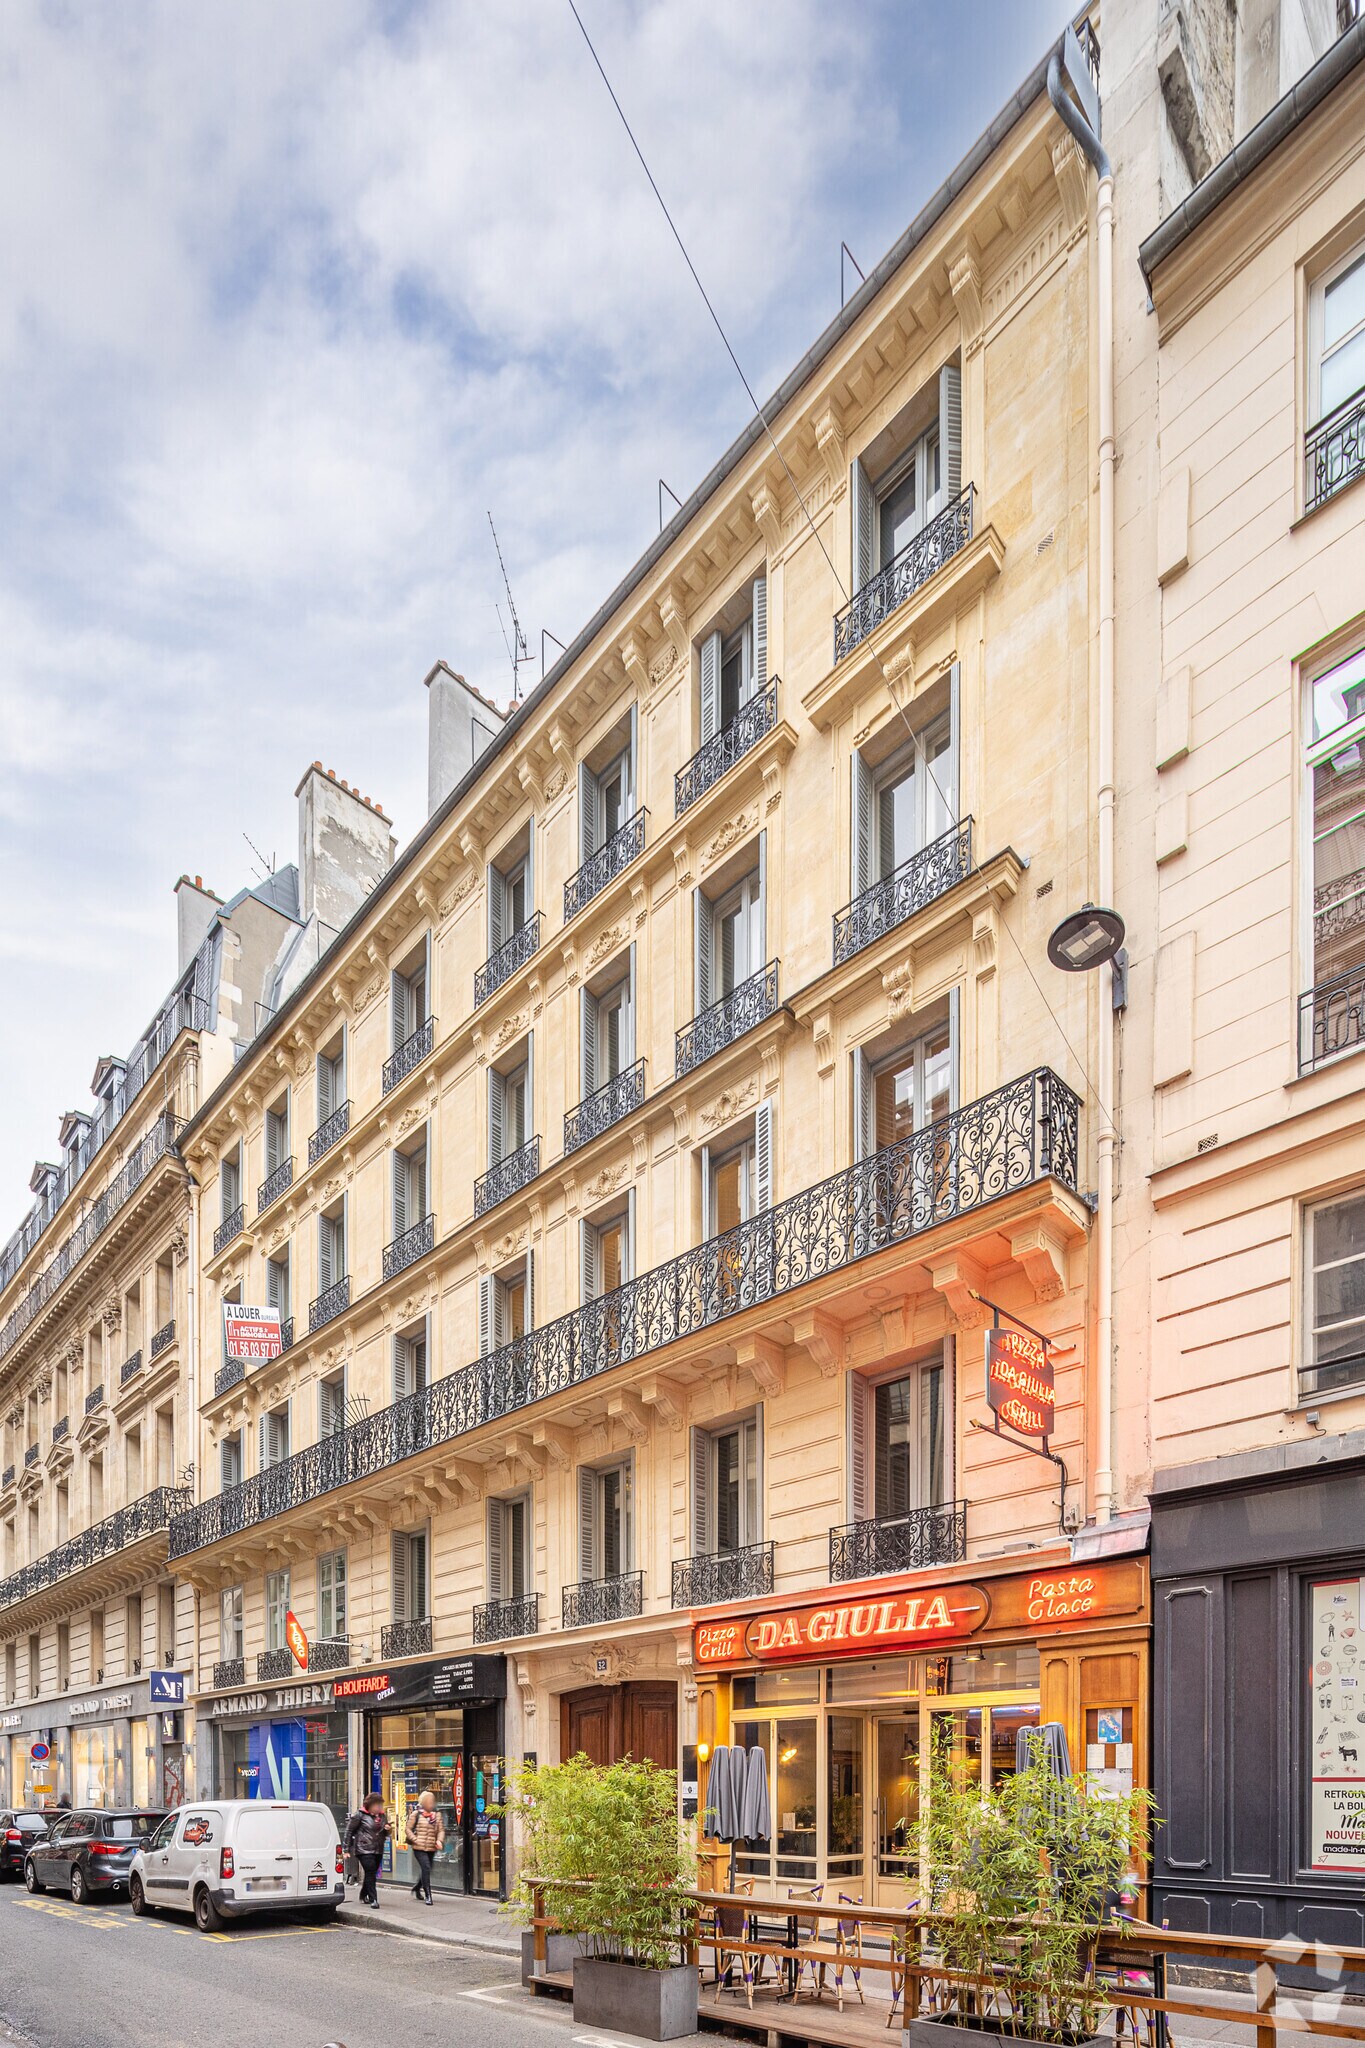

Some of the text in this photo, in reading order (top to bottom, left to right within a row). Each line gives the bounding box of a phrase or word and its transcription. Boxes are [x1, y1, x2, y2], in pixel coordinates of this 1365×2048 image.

[227, 1306, 260, 1320] A LOUER
[240, 1331, 279, 1339] IMMOBILIER
[229, 1341, 238, 1355] 01
[240, 1342, 249, 1356] 56
[250, 1342, 260, 1356] 03
[261, 1343, 270, 1357] 97
[1008, 1333, 1045, 1369] PIZZA
[1017, 1371, 1056, 1404] GIULIA
[1008, 1399, 1045, 1430] GRILL
[1028, 1578, 1096, 1599] Pasta
[1027, 1597, 1092, 1620] Glace
[756, 1595, 955, 1650] DA GIULIA
[289, 1623, 305, 1657] TABAC
[698, 1627, 736, 1644] Pizza
[699, 1641, 733, 1659] Grill
[598, 1660, 607, 1670] 32
[334, 1675, 388, 1696] La BOUFFARDE
[377, 1686, 396, 1701] OPERA
[102, 1693, 133, 1710] THIERY
[212, 1684, 333, 1715] ARMAND THIERY
[1333, 1802, 1345, 1810] LA
